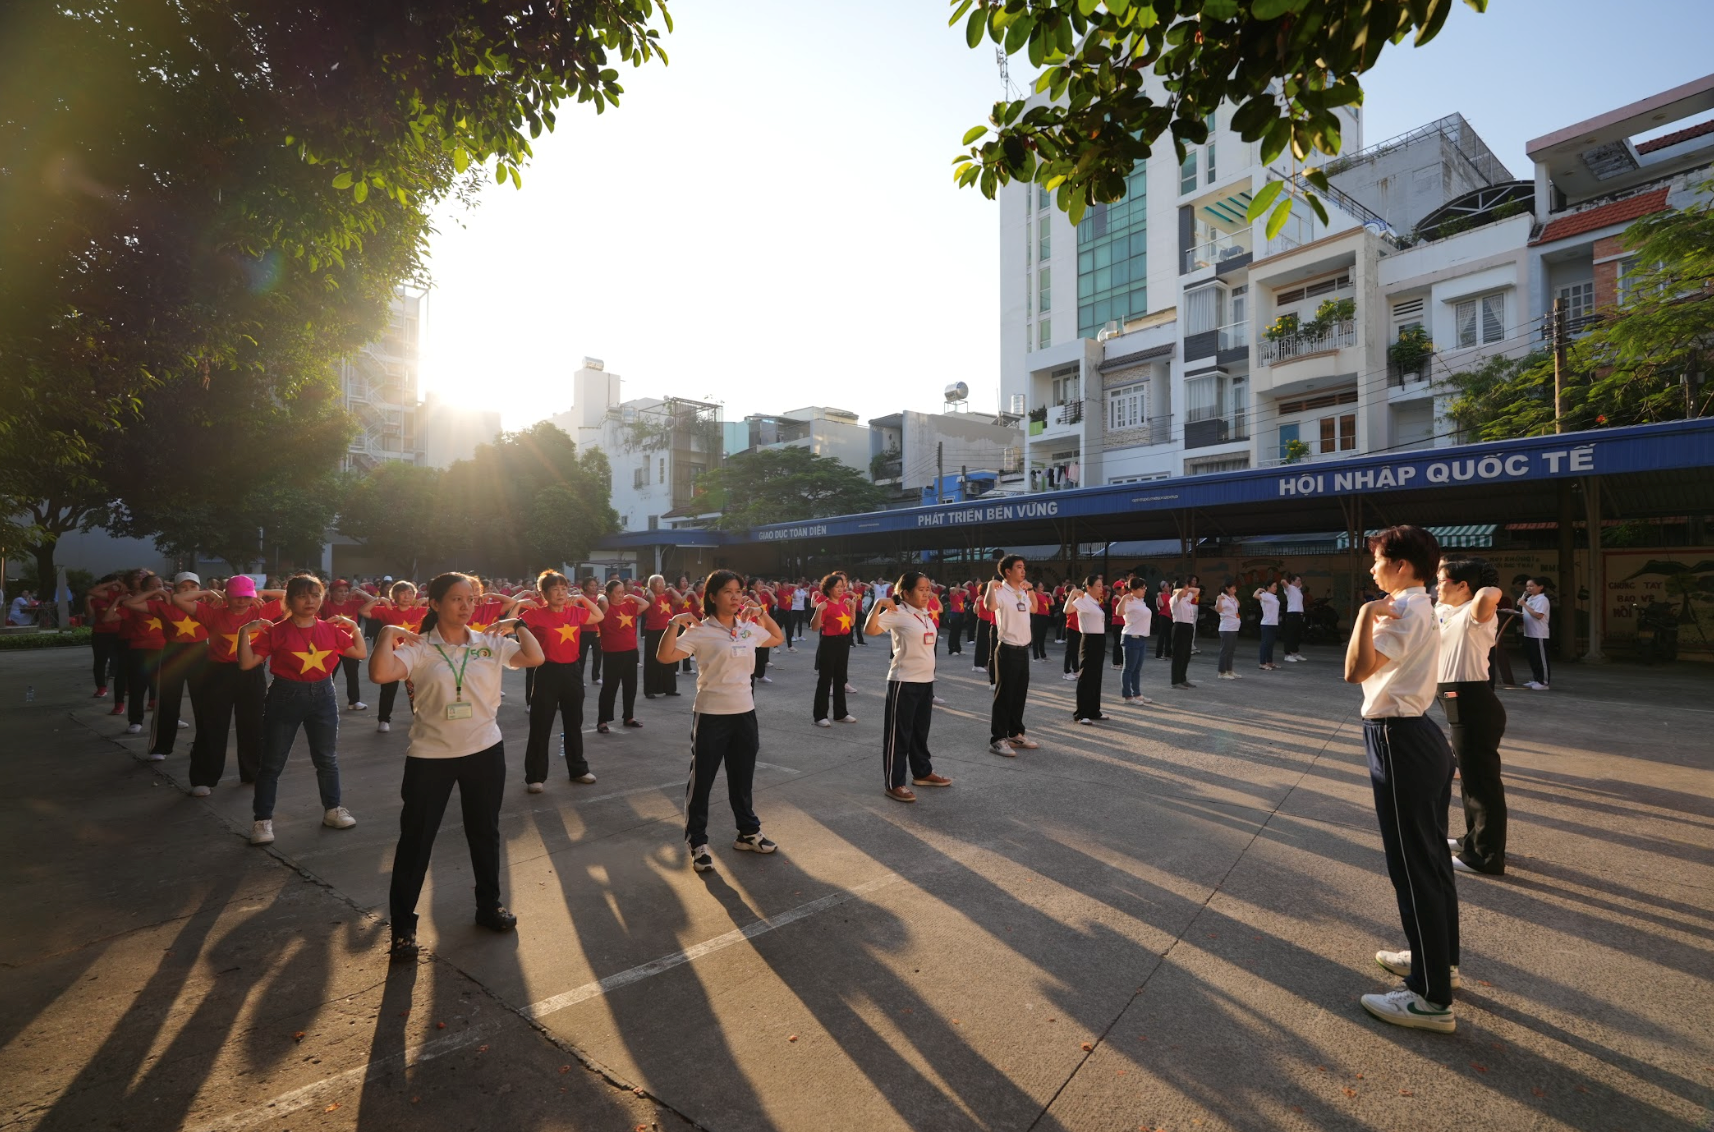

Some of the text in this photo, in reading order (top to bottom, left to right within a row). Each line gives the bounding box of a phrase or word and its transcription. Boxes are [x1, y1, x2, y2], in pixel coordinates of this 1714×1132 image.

[1279, 443, 1597, 496] HỘI NHẬP QUỐC TẾ
[918, 511, 944, 526] PHÁT
[1608, 581, 1662, 590] CHUNG TAY
